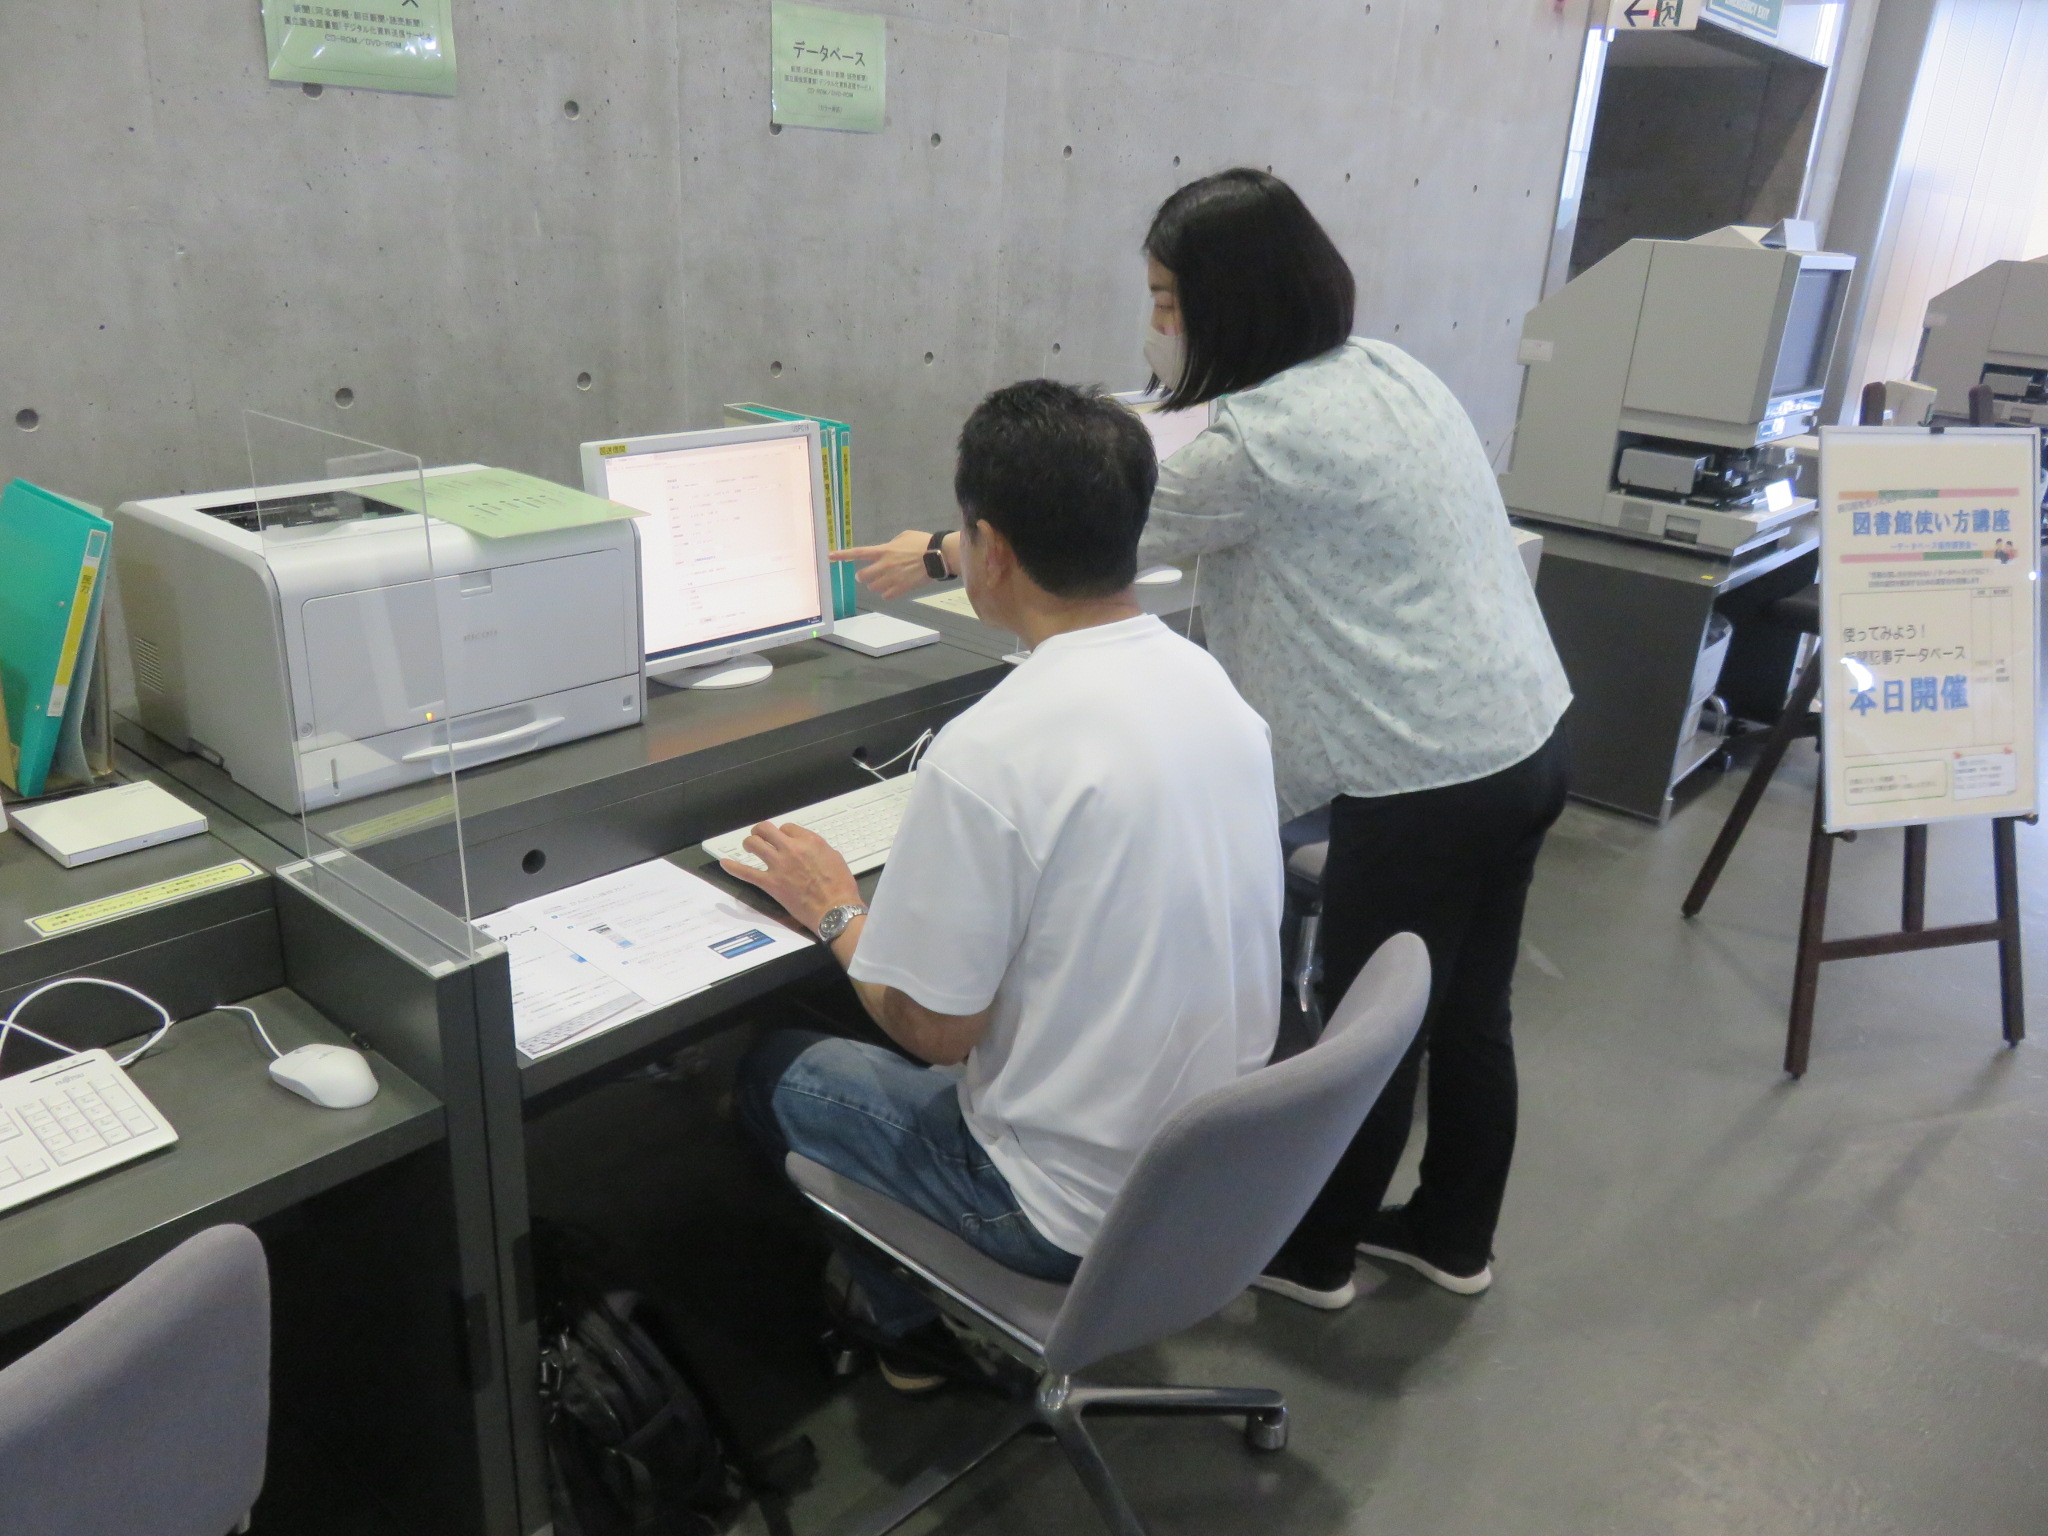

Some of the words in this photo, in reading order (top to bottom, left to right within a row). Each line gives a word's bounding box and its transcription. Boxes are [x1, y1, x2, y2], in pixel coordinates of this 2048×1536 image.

[793, 41, 866, 67] データベース
[1852, 508, 2011, 537] 図書館使い方講座
[1843, 624, 1926, 643] 使ってみよう！
[1849, 674, 1969, 716] 本日開催
